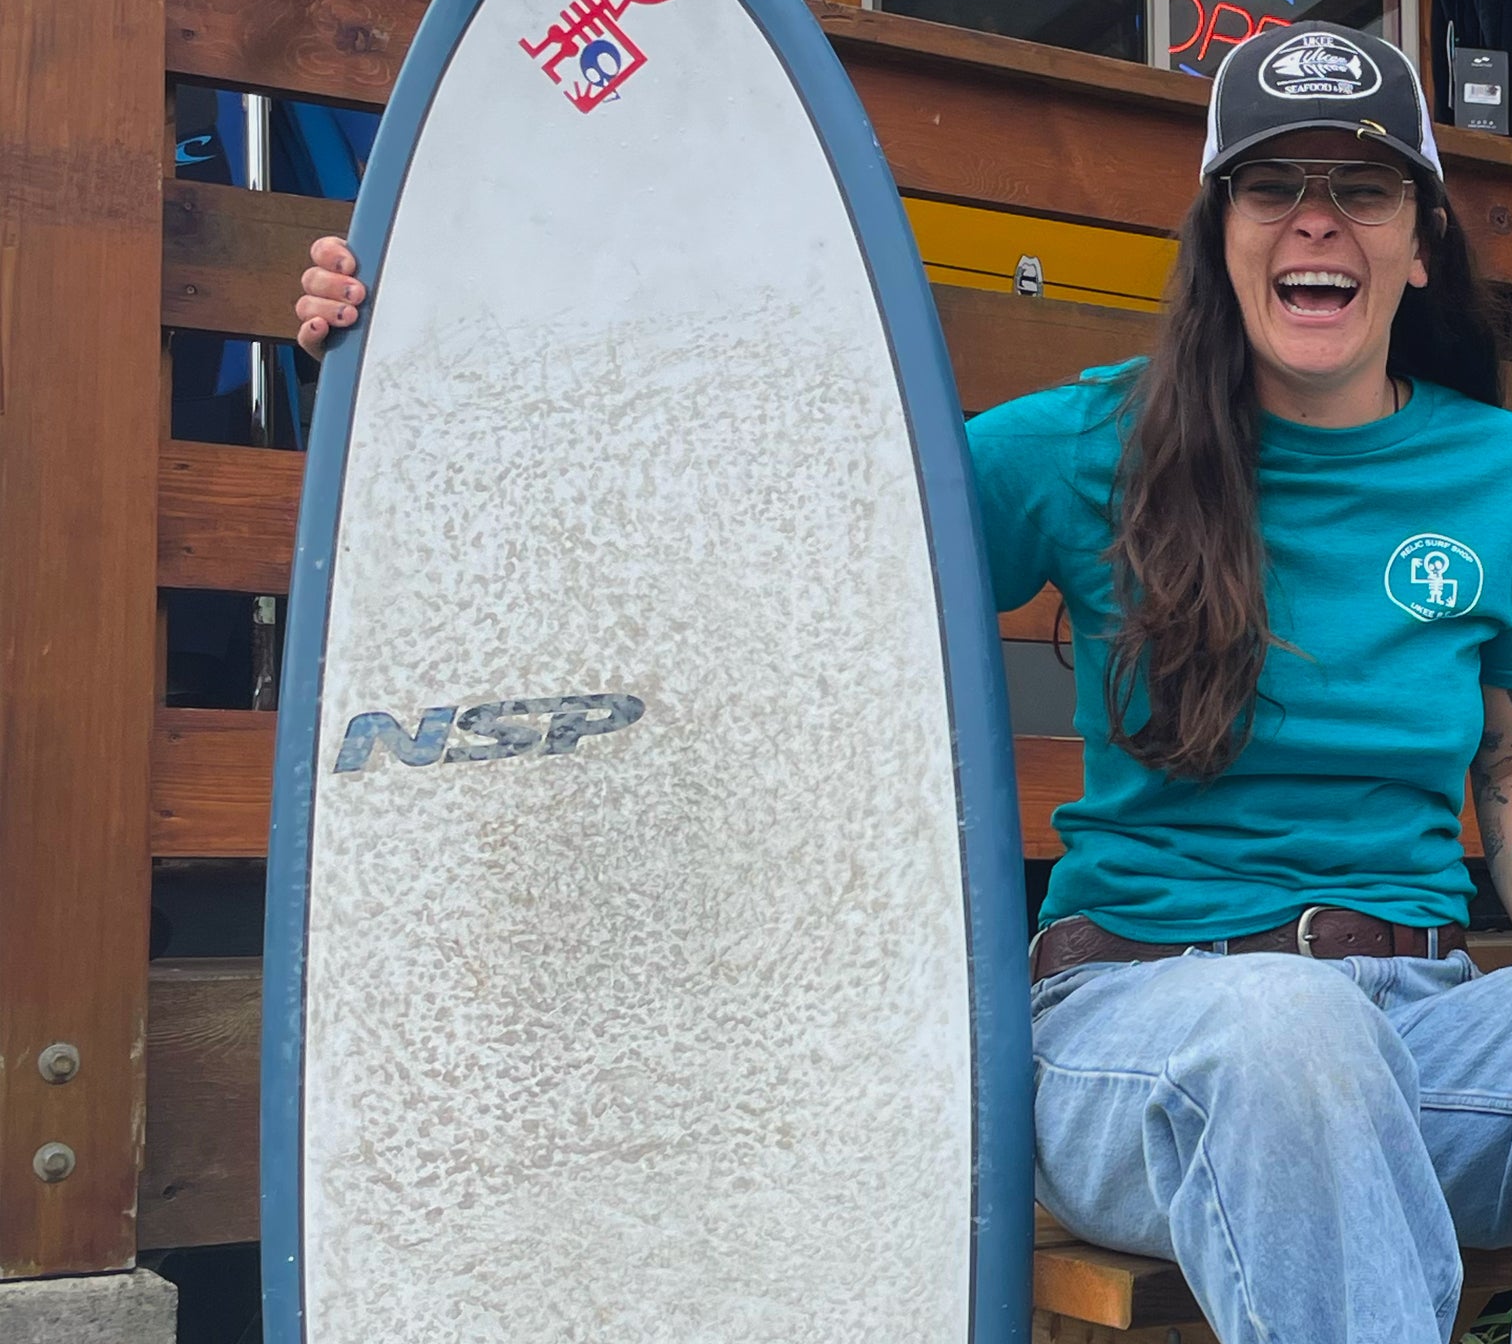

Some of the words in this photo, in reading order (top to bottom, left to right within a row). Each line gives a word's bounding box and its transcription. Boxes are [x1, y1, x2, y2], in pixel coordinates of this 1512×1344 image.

[1285, 83, 1331, 94] SEAFOOD
[1400, 540, 1424, 558] RELIC
[1425, 539, 1451, 548] SURF
[1451, 545, 1474, 563] SHOP
[1410, 602, 1435, 618] UKEE
[332, 693, 646, 774] NSP
